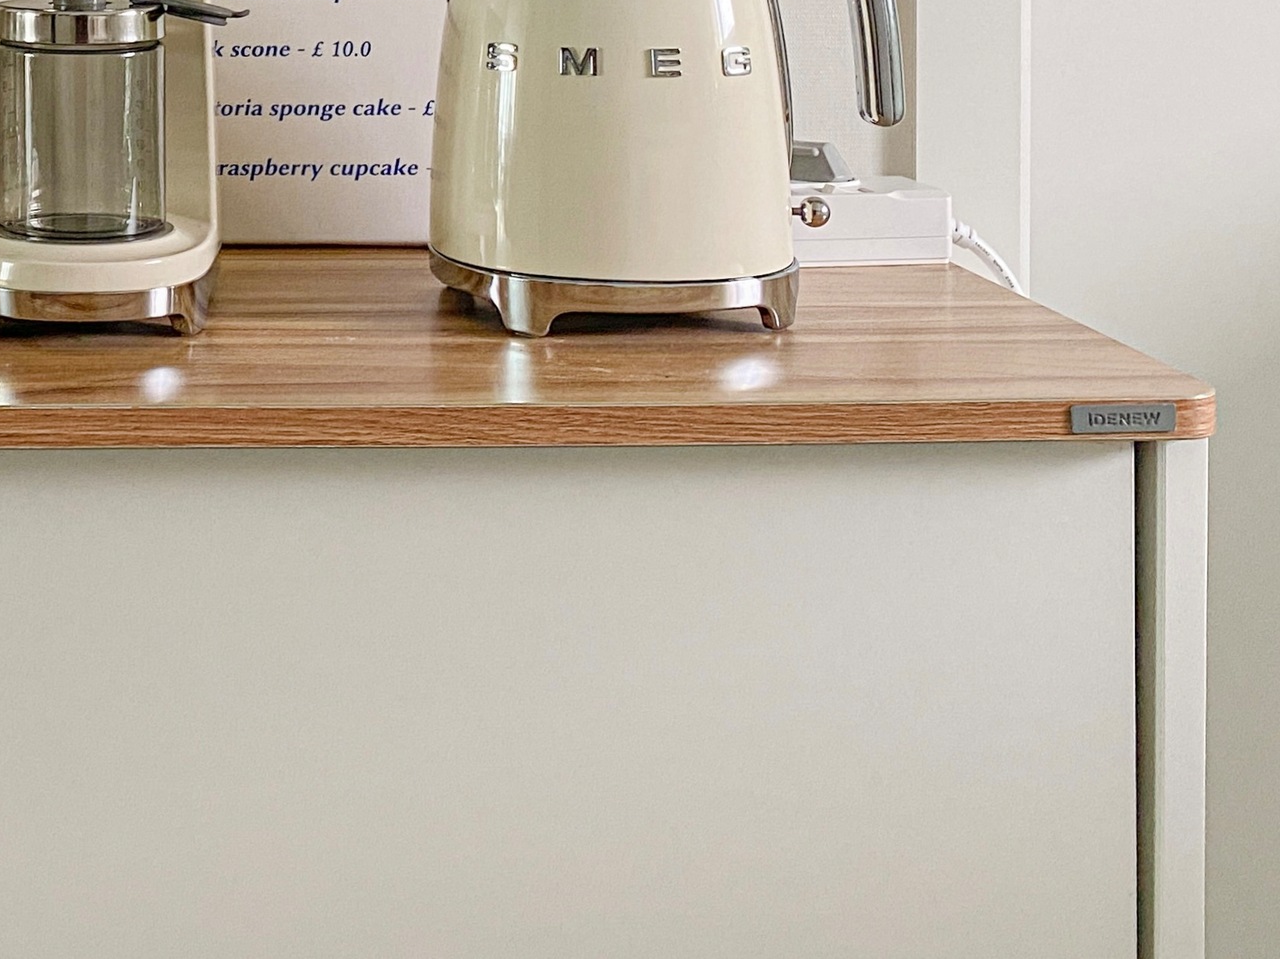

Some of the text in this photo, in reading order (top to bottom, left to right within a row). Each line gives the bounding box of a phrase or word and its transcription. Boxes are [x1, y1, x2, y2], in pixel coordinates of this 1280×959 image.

[230, 44, 291, 58] scone
[311, 41, 324, 58] £
[332, 40, 372, 58] 10.0
[486, 42, 752, 77] SMEG
[268, 100, 346, 122] sponge
[352, 98, 402, 117] cake
[422, 100, 435, 116] £
[218, 157, 324, 182] raspberry
[329, 157, 419, 182] cupcake
[1088, 411, 1161, 427] IDENEW
